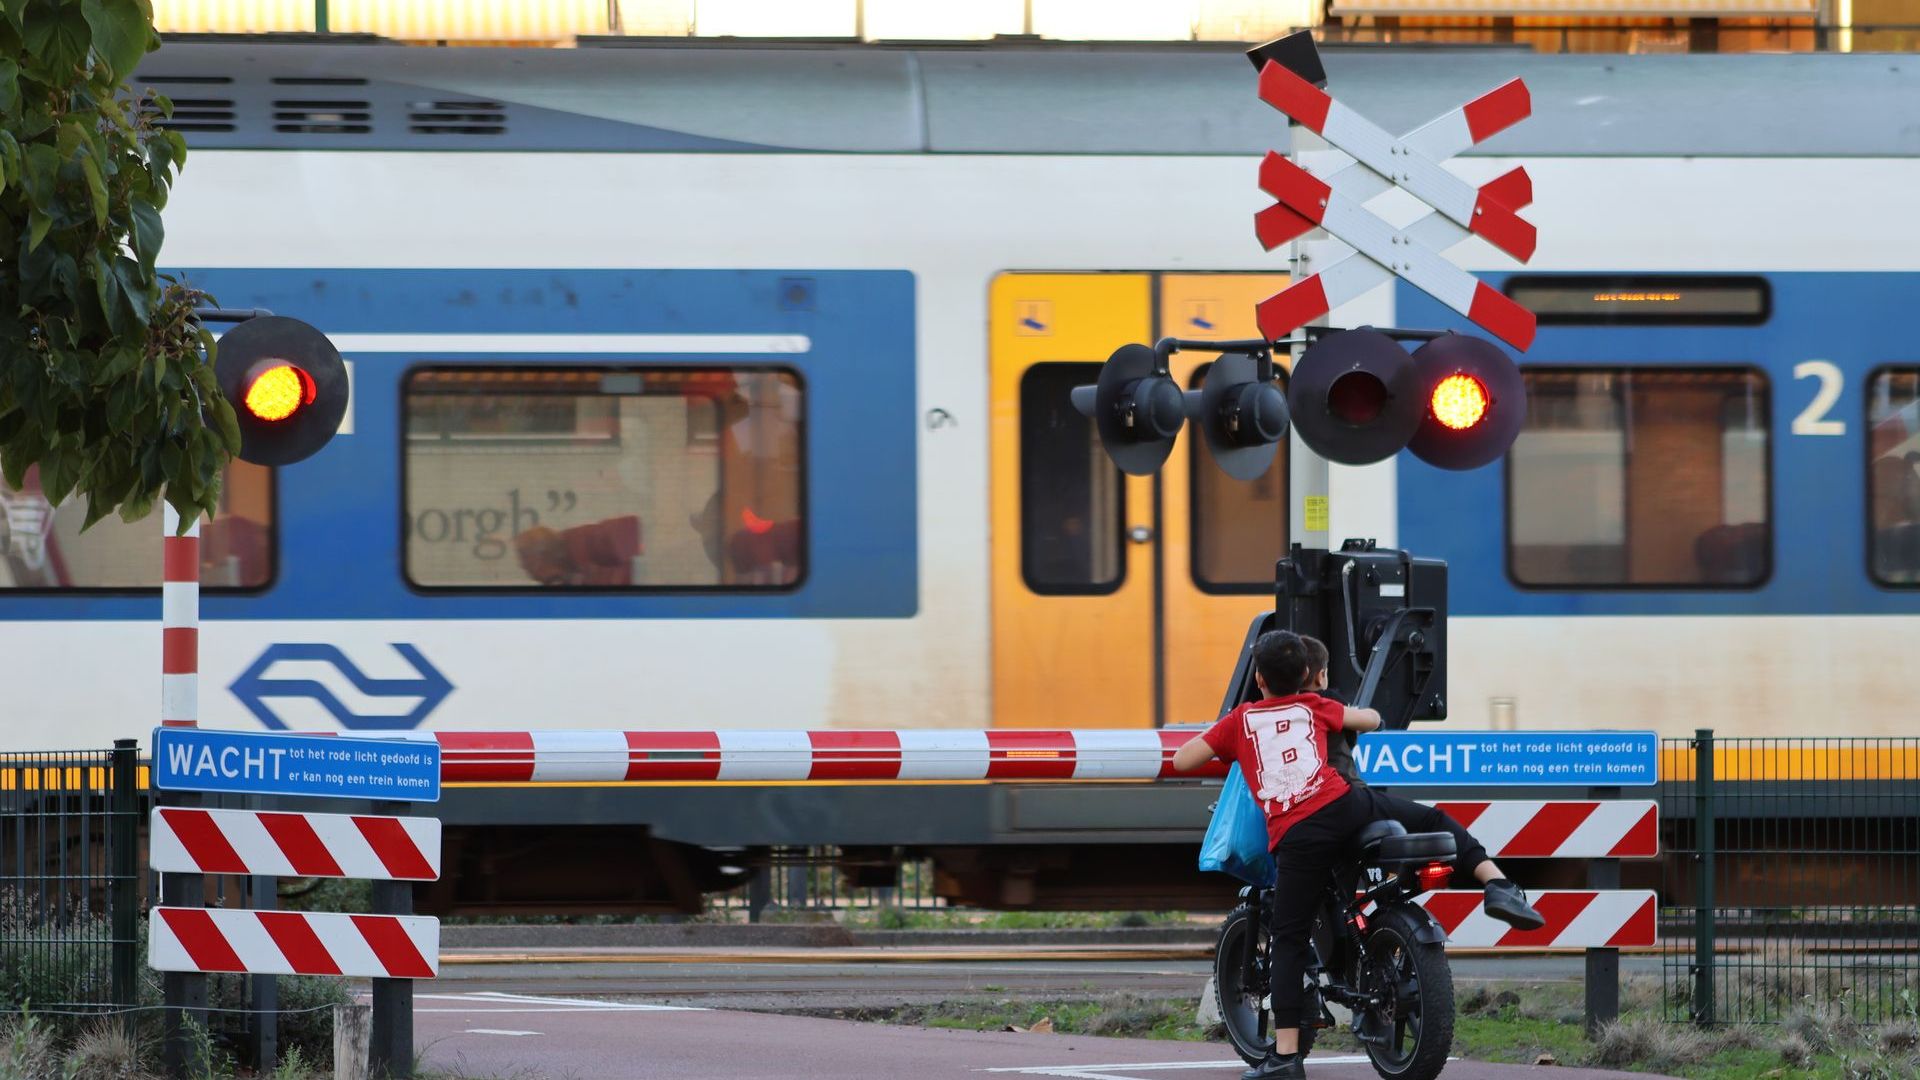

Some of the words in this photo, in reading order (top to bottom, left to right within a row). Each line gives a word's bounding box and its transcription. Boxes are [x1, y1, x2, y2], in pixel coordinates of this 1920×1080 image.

[1791, 361, 1846, 435] 2
[289, 747, 305, 760] tot
[308, 748, 325, 761] het
[328, 750, 351, 762] rode
[354, 750, 378, 763] licht
[381, 753, 420, 766] gedoofd
[423, 754, 433, 766] is
[1243, 703, 1323, 806] B
[1481, 742, 1498, 753] tot
[1502, 742, 1521, 753] het
[1526, 742, 1552, 753] rode
[1556, 742, 1583, 753] licht
[1587, 742, 1632, 756] gedoofd
[1637, 742, 1648, 753] is
[168, 743, 286, 780] WACHT
[1480, 763, 1493, 774] er
[1497, 762, 1518, 774] kan
[1523, 763, 1544, 776] nog
[1548, 764, 1569, 774] een
[1574, 762, 1602, 774] trein
[1607, 762, 1645, 774] komen
[288, 771, 300, 782] er
[303, 771, 321, 783] kan
[325, 773, 344, 786] nog
[347, 775, 365, 785] een
[368, 774, 393, 786] trein
[397, 776, 430, 788] komen
